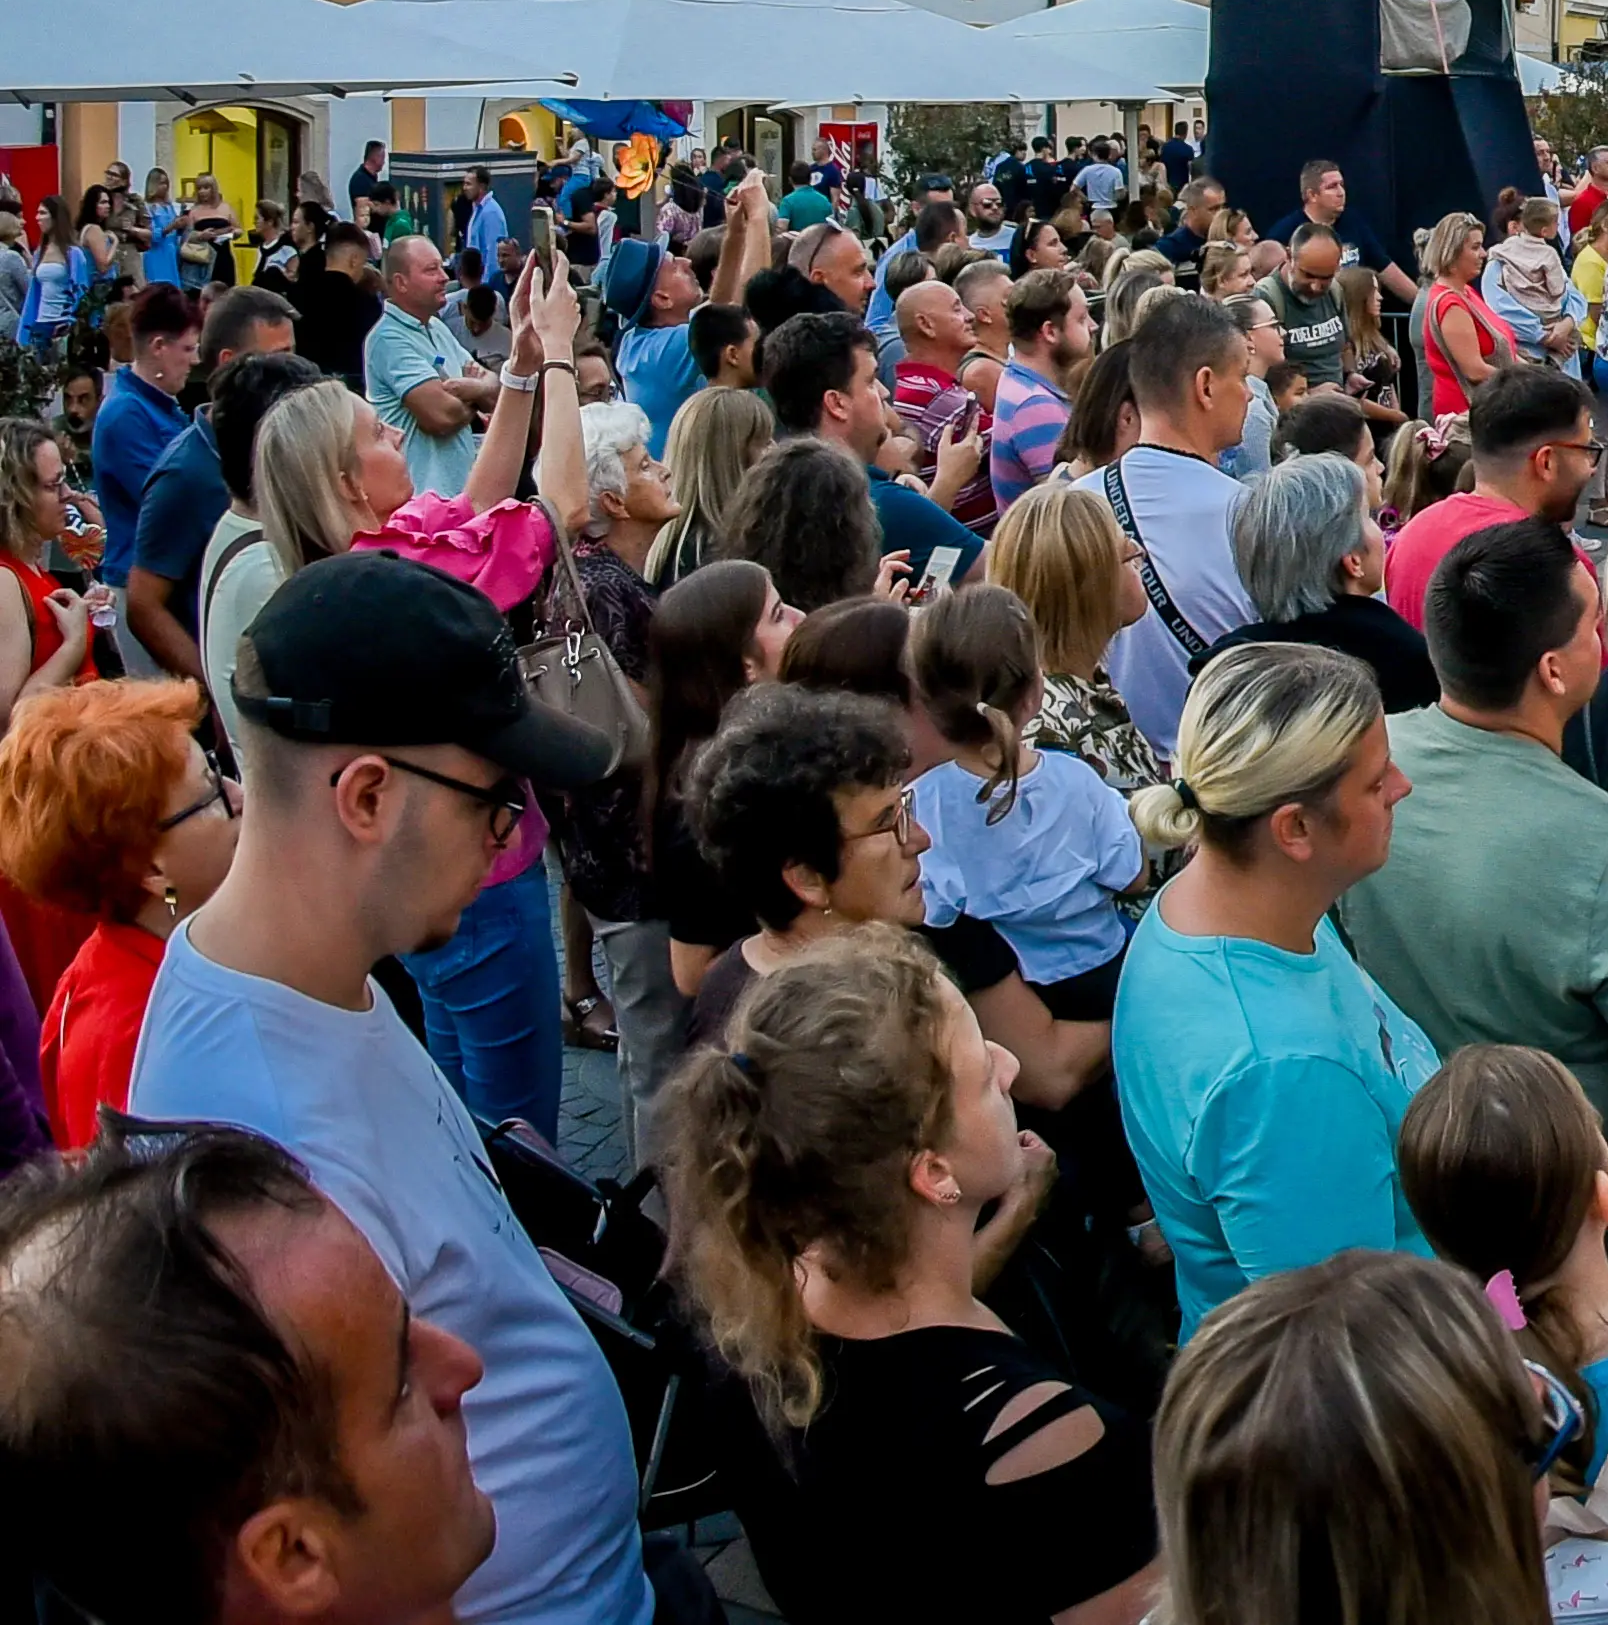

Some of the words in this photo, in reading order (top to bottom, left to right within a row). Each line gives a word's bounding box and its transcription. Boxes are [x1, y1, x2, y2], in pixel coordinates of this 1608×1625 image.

[1106, 467, 1131, 527] UNDER
[1124, 529, 1168, 609] AOUR
[1171, 617, 1204, 655] UND
